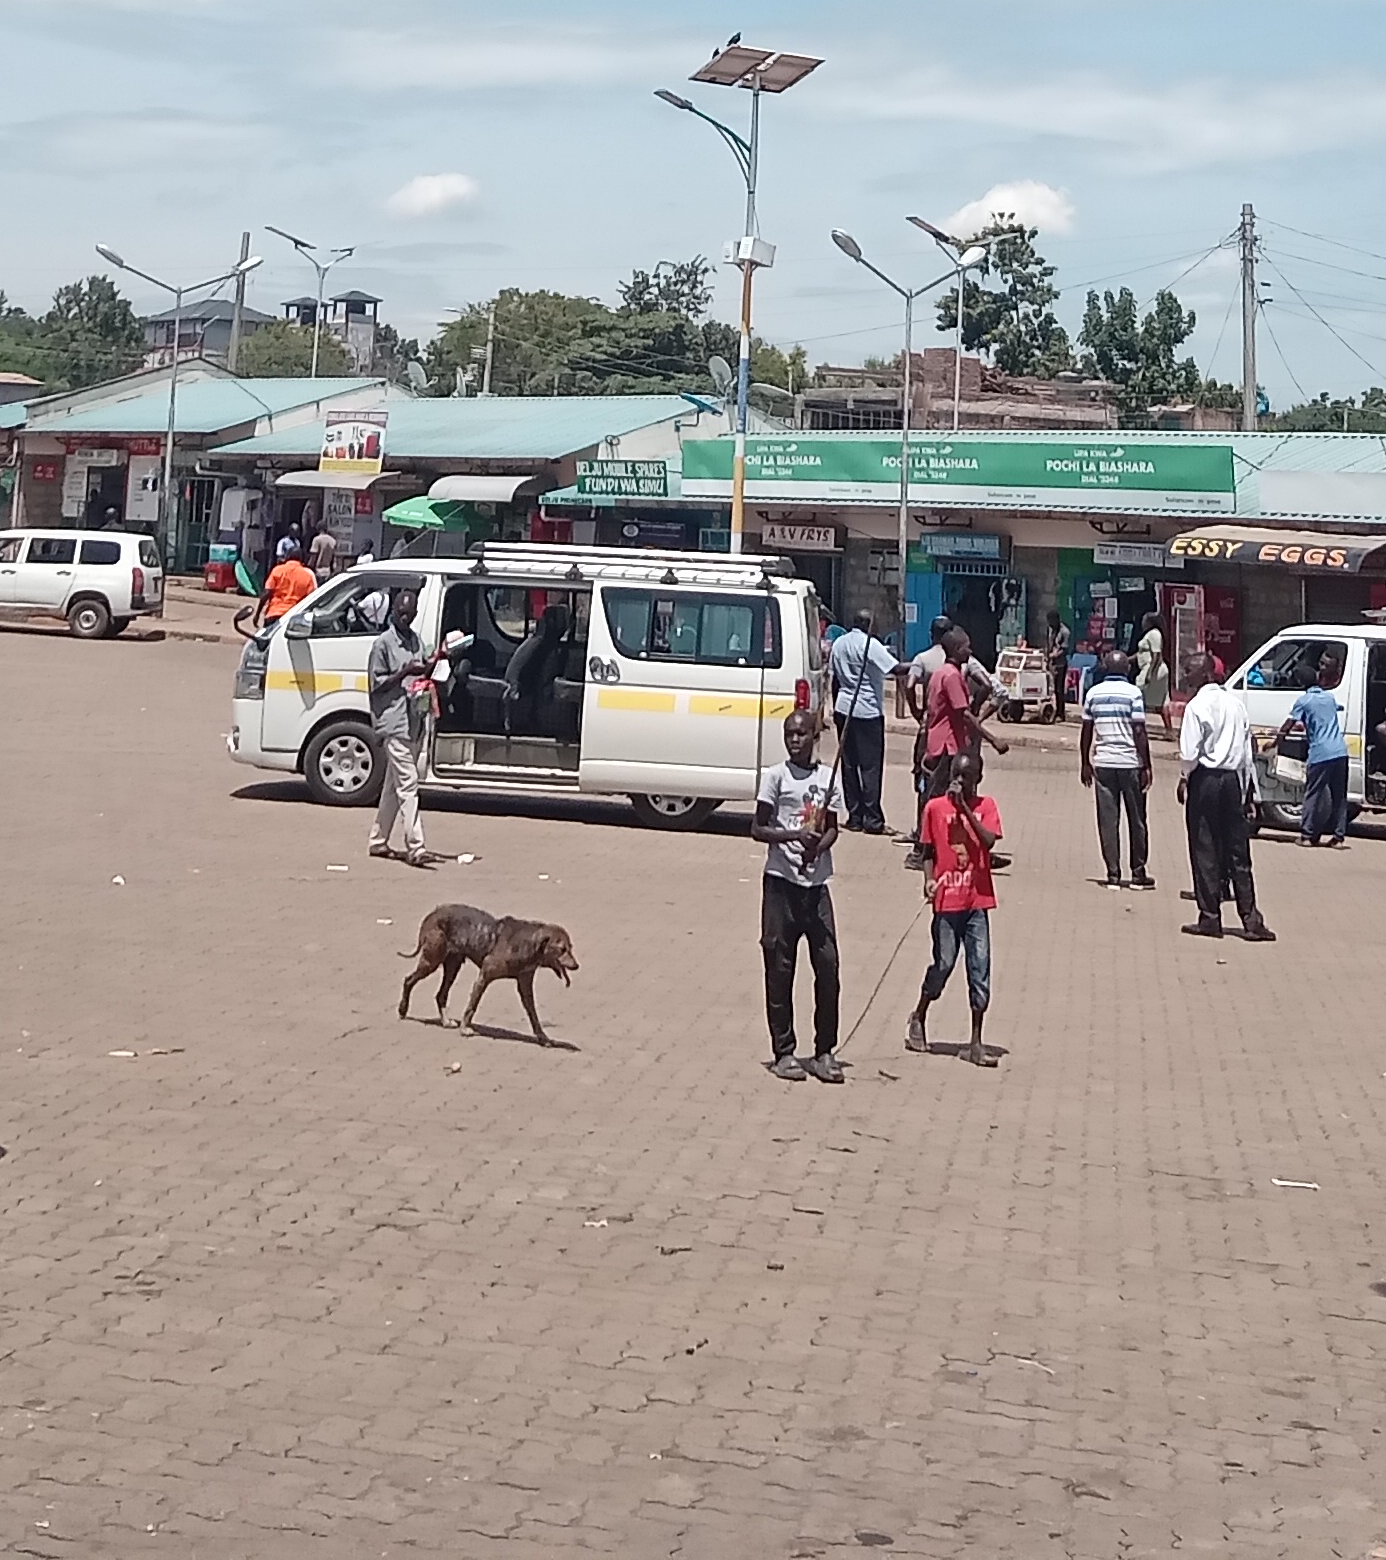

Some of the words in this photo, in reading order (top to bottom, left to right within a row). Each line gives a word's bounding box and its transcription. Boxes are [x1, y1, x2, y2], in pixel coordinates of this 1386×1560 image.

[763, 455, 775, 466] LA
[776, 455, 822, 466] BIASHARA
[882, 456, 913, 468] POCI
[915, 457, 928, 468] LA
[929, 458, 979, 470] BIASHARA
[1046, 460, 1080, 472] POCHI
[1082, 460, 1097, 472] LA
[1099, 461, 1155, 474] BIASHARA
[635, 463, 665, 477] SPARES
[585, 477, 619, 492] FUNDI
[620, 478, 638, 493] WA
[639, 478, 664, 493] SIMU
[768, 527, 775, 538] A
[789, 527, 796, 539] V
[1170, 538, 1243, 558] ESSY
[1258, 544, 1350, 569] EGGS.
